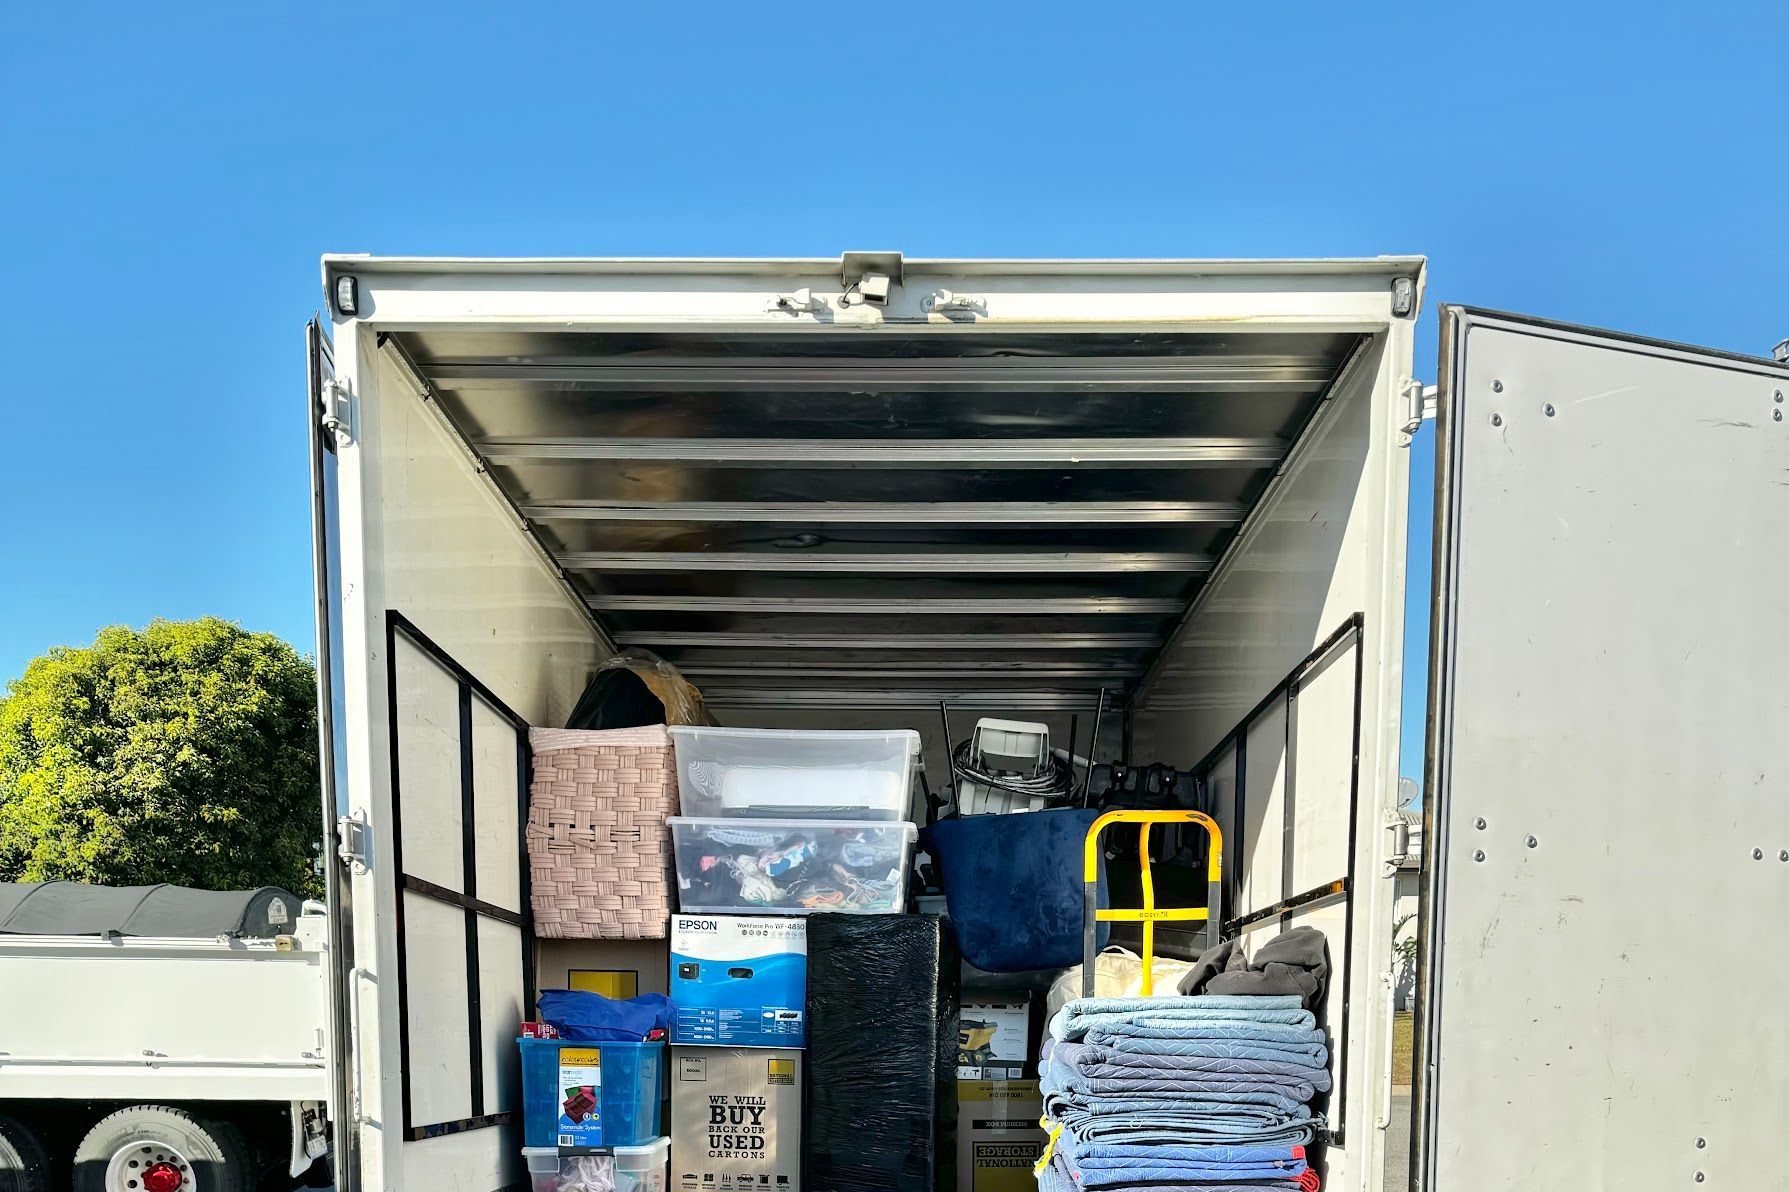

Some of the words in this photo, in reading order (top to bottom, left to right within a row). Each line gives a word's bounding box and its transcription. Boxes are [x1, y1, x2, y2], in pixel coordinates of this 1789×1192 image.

[679, 920, 717, 930] EPSON
[708, 1095, 728, 1104] WE
[734, 1096, 766, 1105] WILL
[709, 1105, 766, 1125] BUY
[743, 1126, 765, 1134] OUR
[708, 1134, 765, 1149] USED
[708, 1150, 765, 1159] CARTONS
[978, 1147, 1034, 1156] STORAGE
